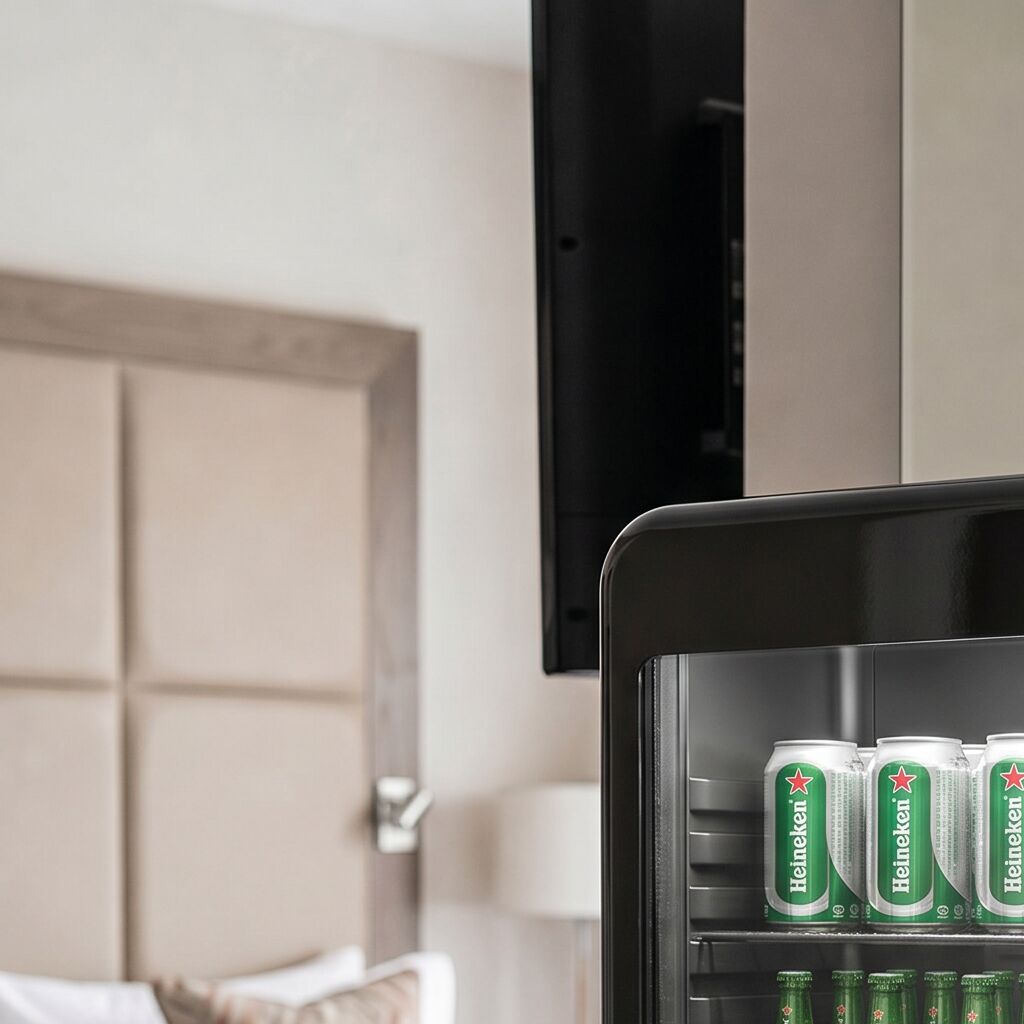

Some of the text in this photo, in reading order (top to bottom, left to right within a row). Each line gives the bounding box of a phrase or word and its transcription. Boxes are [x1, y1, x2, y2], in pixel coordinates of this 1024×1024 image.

[789, 799, 807, 893] Heineken
[892, 798, 910, 893] Heineken
[1003, 796, 1022, 893] Heineken
